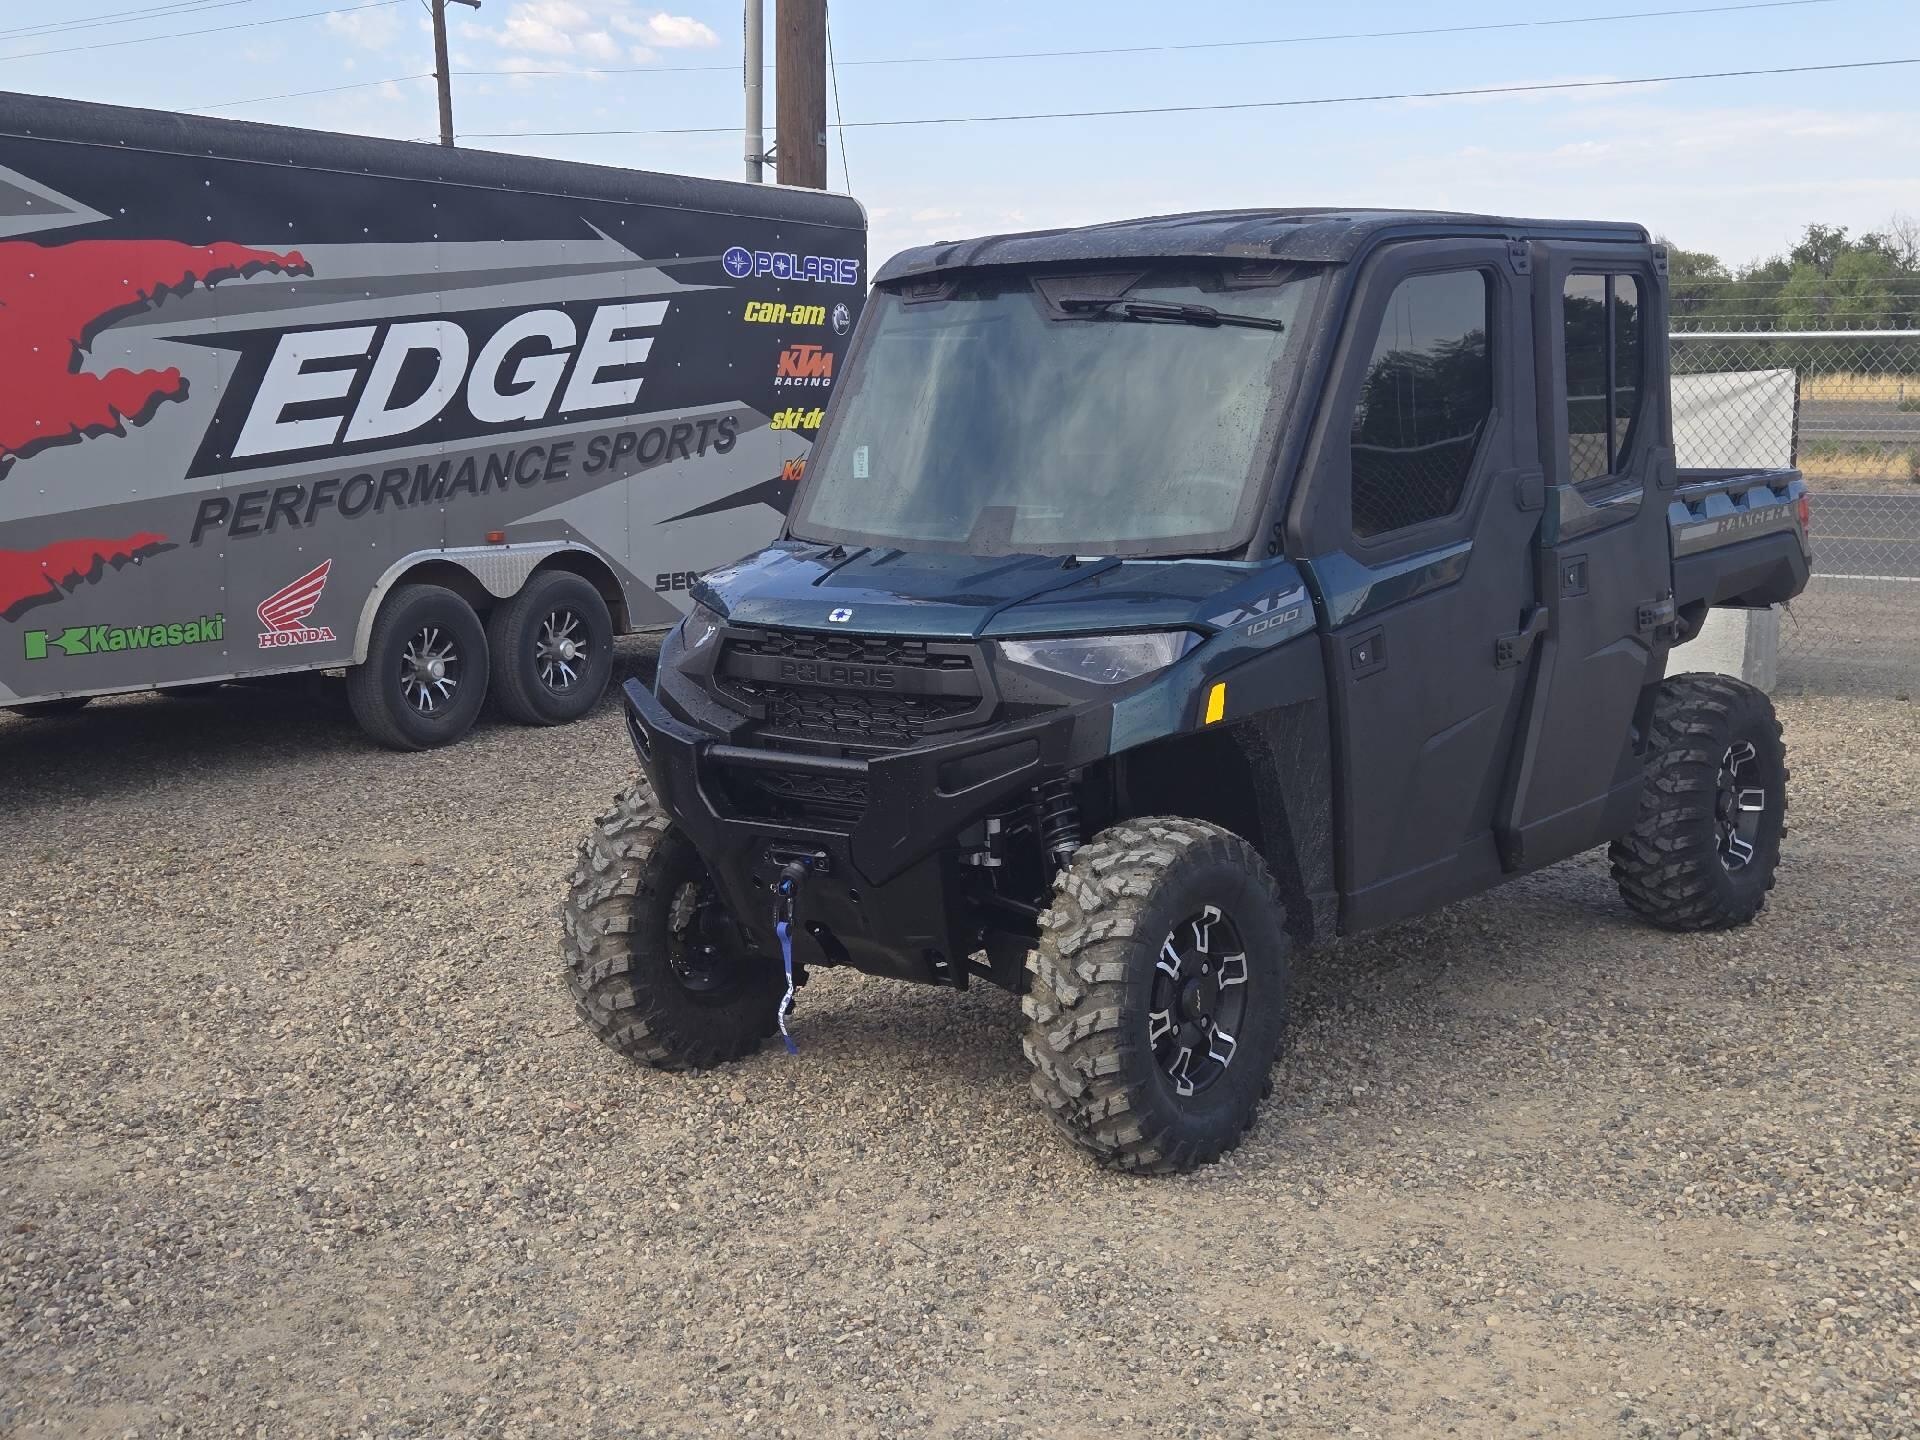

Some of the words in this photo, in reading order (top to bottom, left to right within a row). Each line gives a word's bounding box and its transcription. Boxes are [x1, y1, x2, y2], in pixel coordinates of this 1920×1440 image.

[754, 251, 859, 285] POLARIS
[777, 344, 833, 377] KTM
[231, 300, 670, 458] EDGE
[774, 376, 831, 387] RACING
[189, 441, 574, 544] PERFORMANCE
[582, 415, 739, 473] SPORTS
[1717, 505, 1791, 533] RANGER
[88, 612, 225, 653] Kawasaki
[259, 626, 336, 648] HONDA
[1247, 608, 1299, 636] 1000
[780, 661, 897, 689] POLARIS
